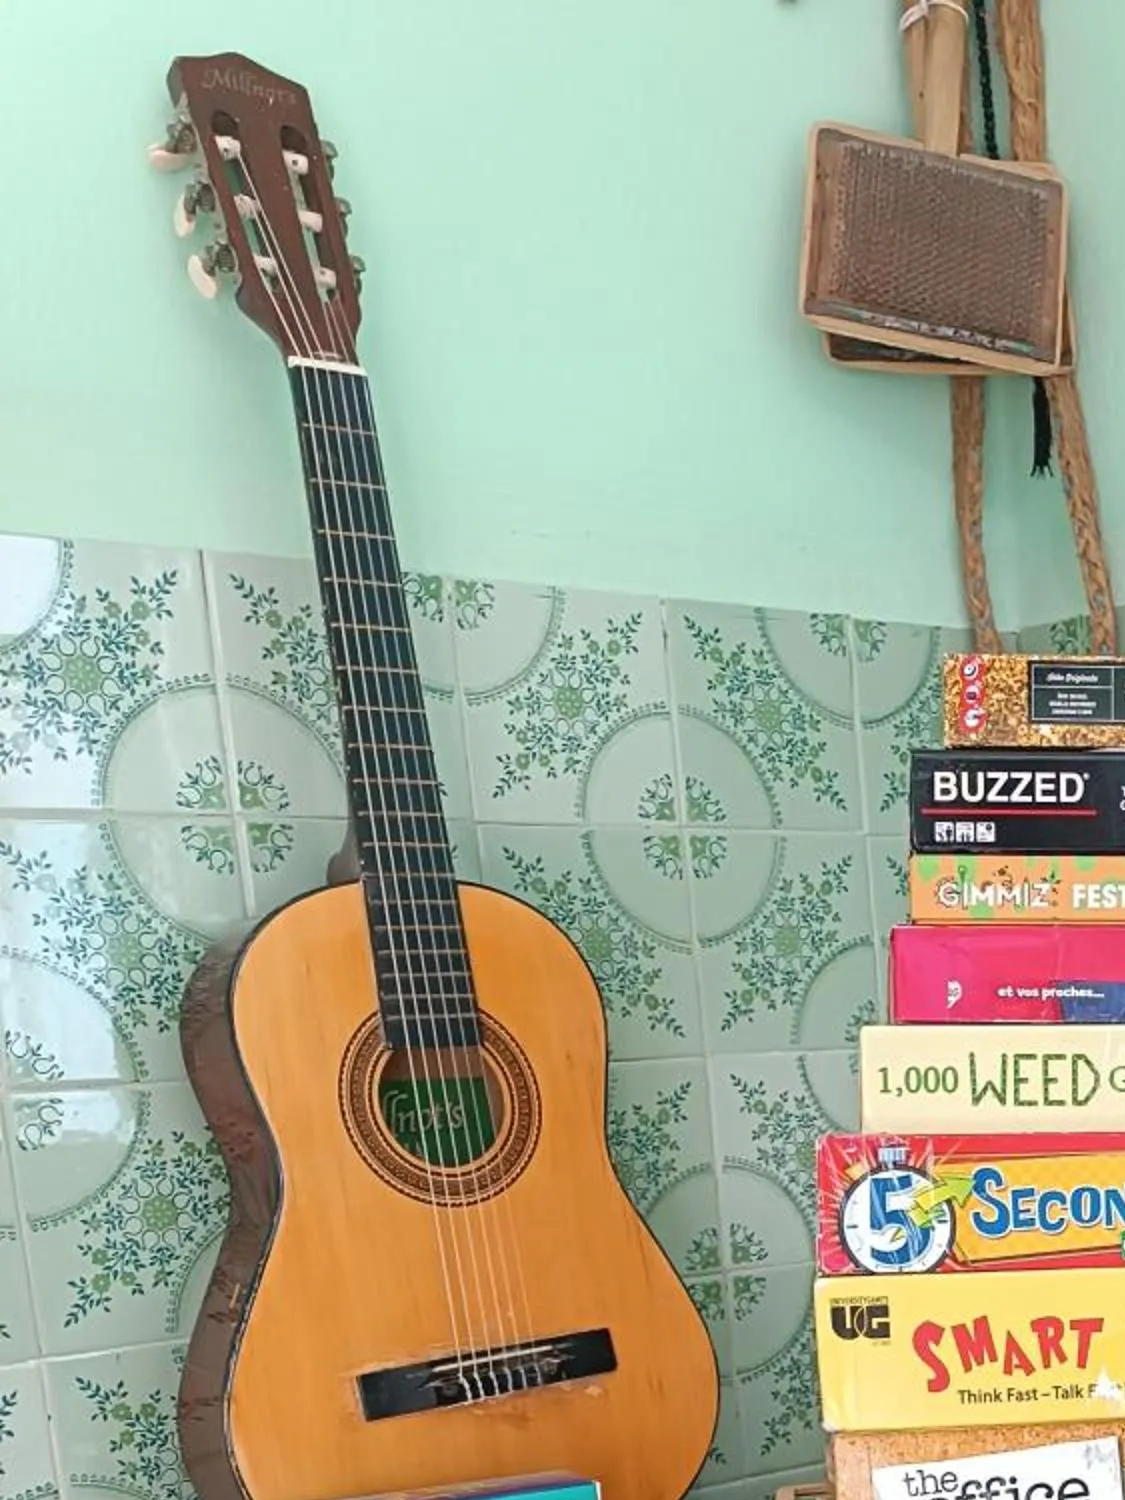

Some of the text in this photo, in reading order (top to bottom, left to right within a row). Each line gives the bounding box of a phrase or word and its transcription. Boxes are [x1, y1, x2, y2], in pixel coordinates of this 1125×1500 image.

[937, 881, 1051, 908] GIMMIZ
[998, 986, 1105, 1001] et vos proches...
[877, 1067, 959, 1099] 1,000
[969, 1052, 1100, 1107] WEED
[870, 1174, 932, 1265] 5
[831, 1305, 891, 1340] UG
[912, 1314, 1104, 1393] SMART
[958, 1388, 1003, 1404] Think
[1007, 1387, 1039, 1401] Fast
[1053, 1384, 1084, 1400] Talk
[903, 1470, 958, 1497] the
